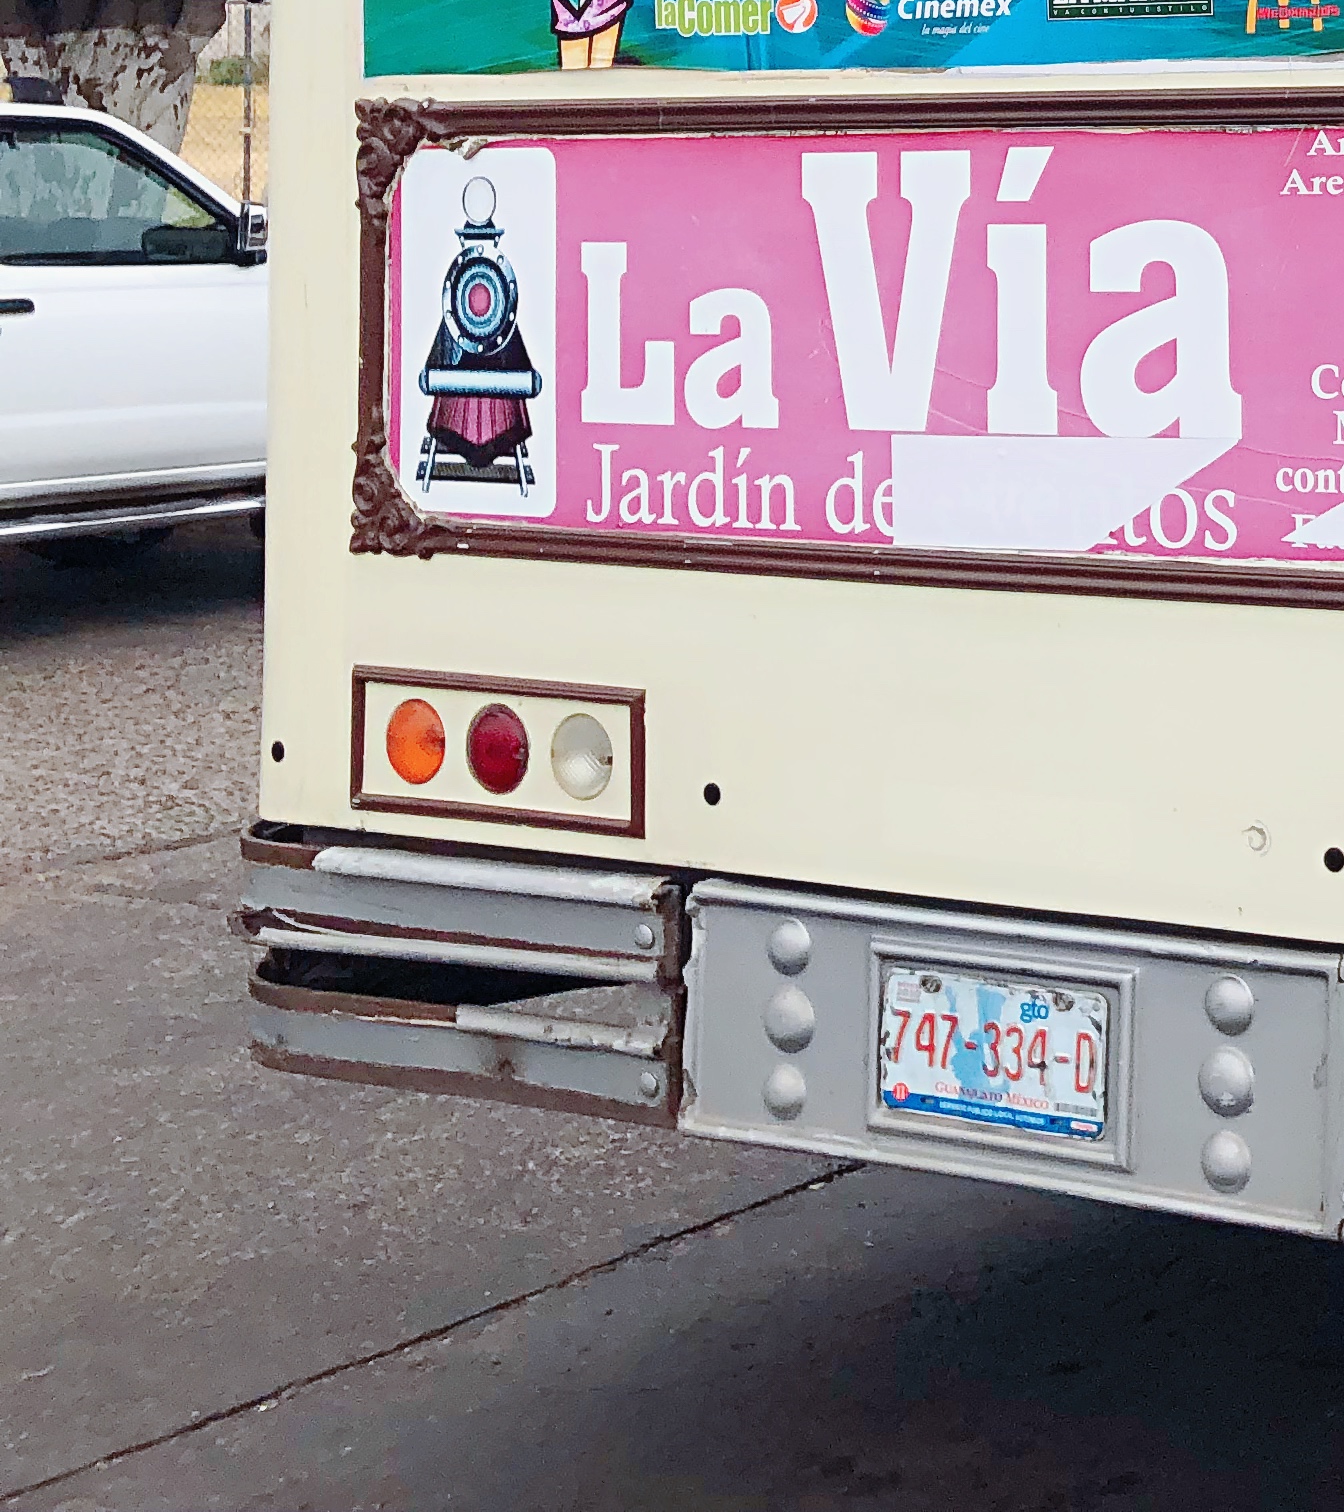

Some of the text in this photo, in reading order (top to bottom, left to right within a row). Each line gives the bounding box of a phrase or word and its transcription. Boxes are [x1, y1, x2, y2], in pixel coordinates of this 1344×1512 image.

[581, 145, 1242, 439] La Vía
[585, 442, 802, 531] Jardín
[890, 1008, 1097, 1094] 747-334-D
[1019, 998, 1049, 1023] gto
